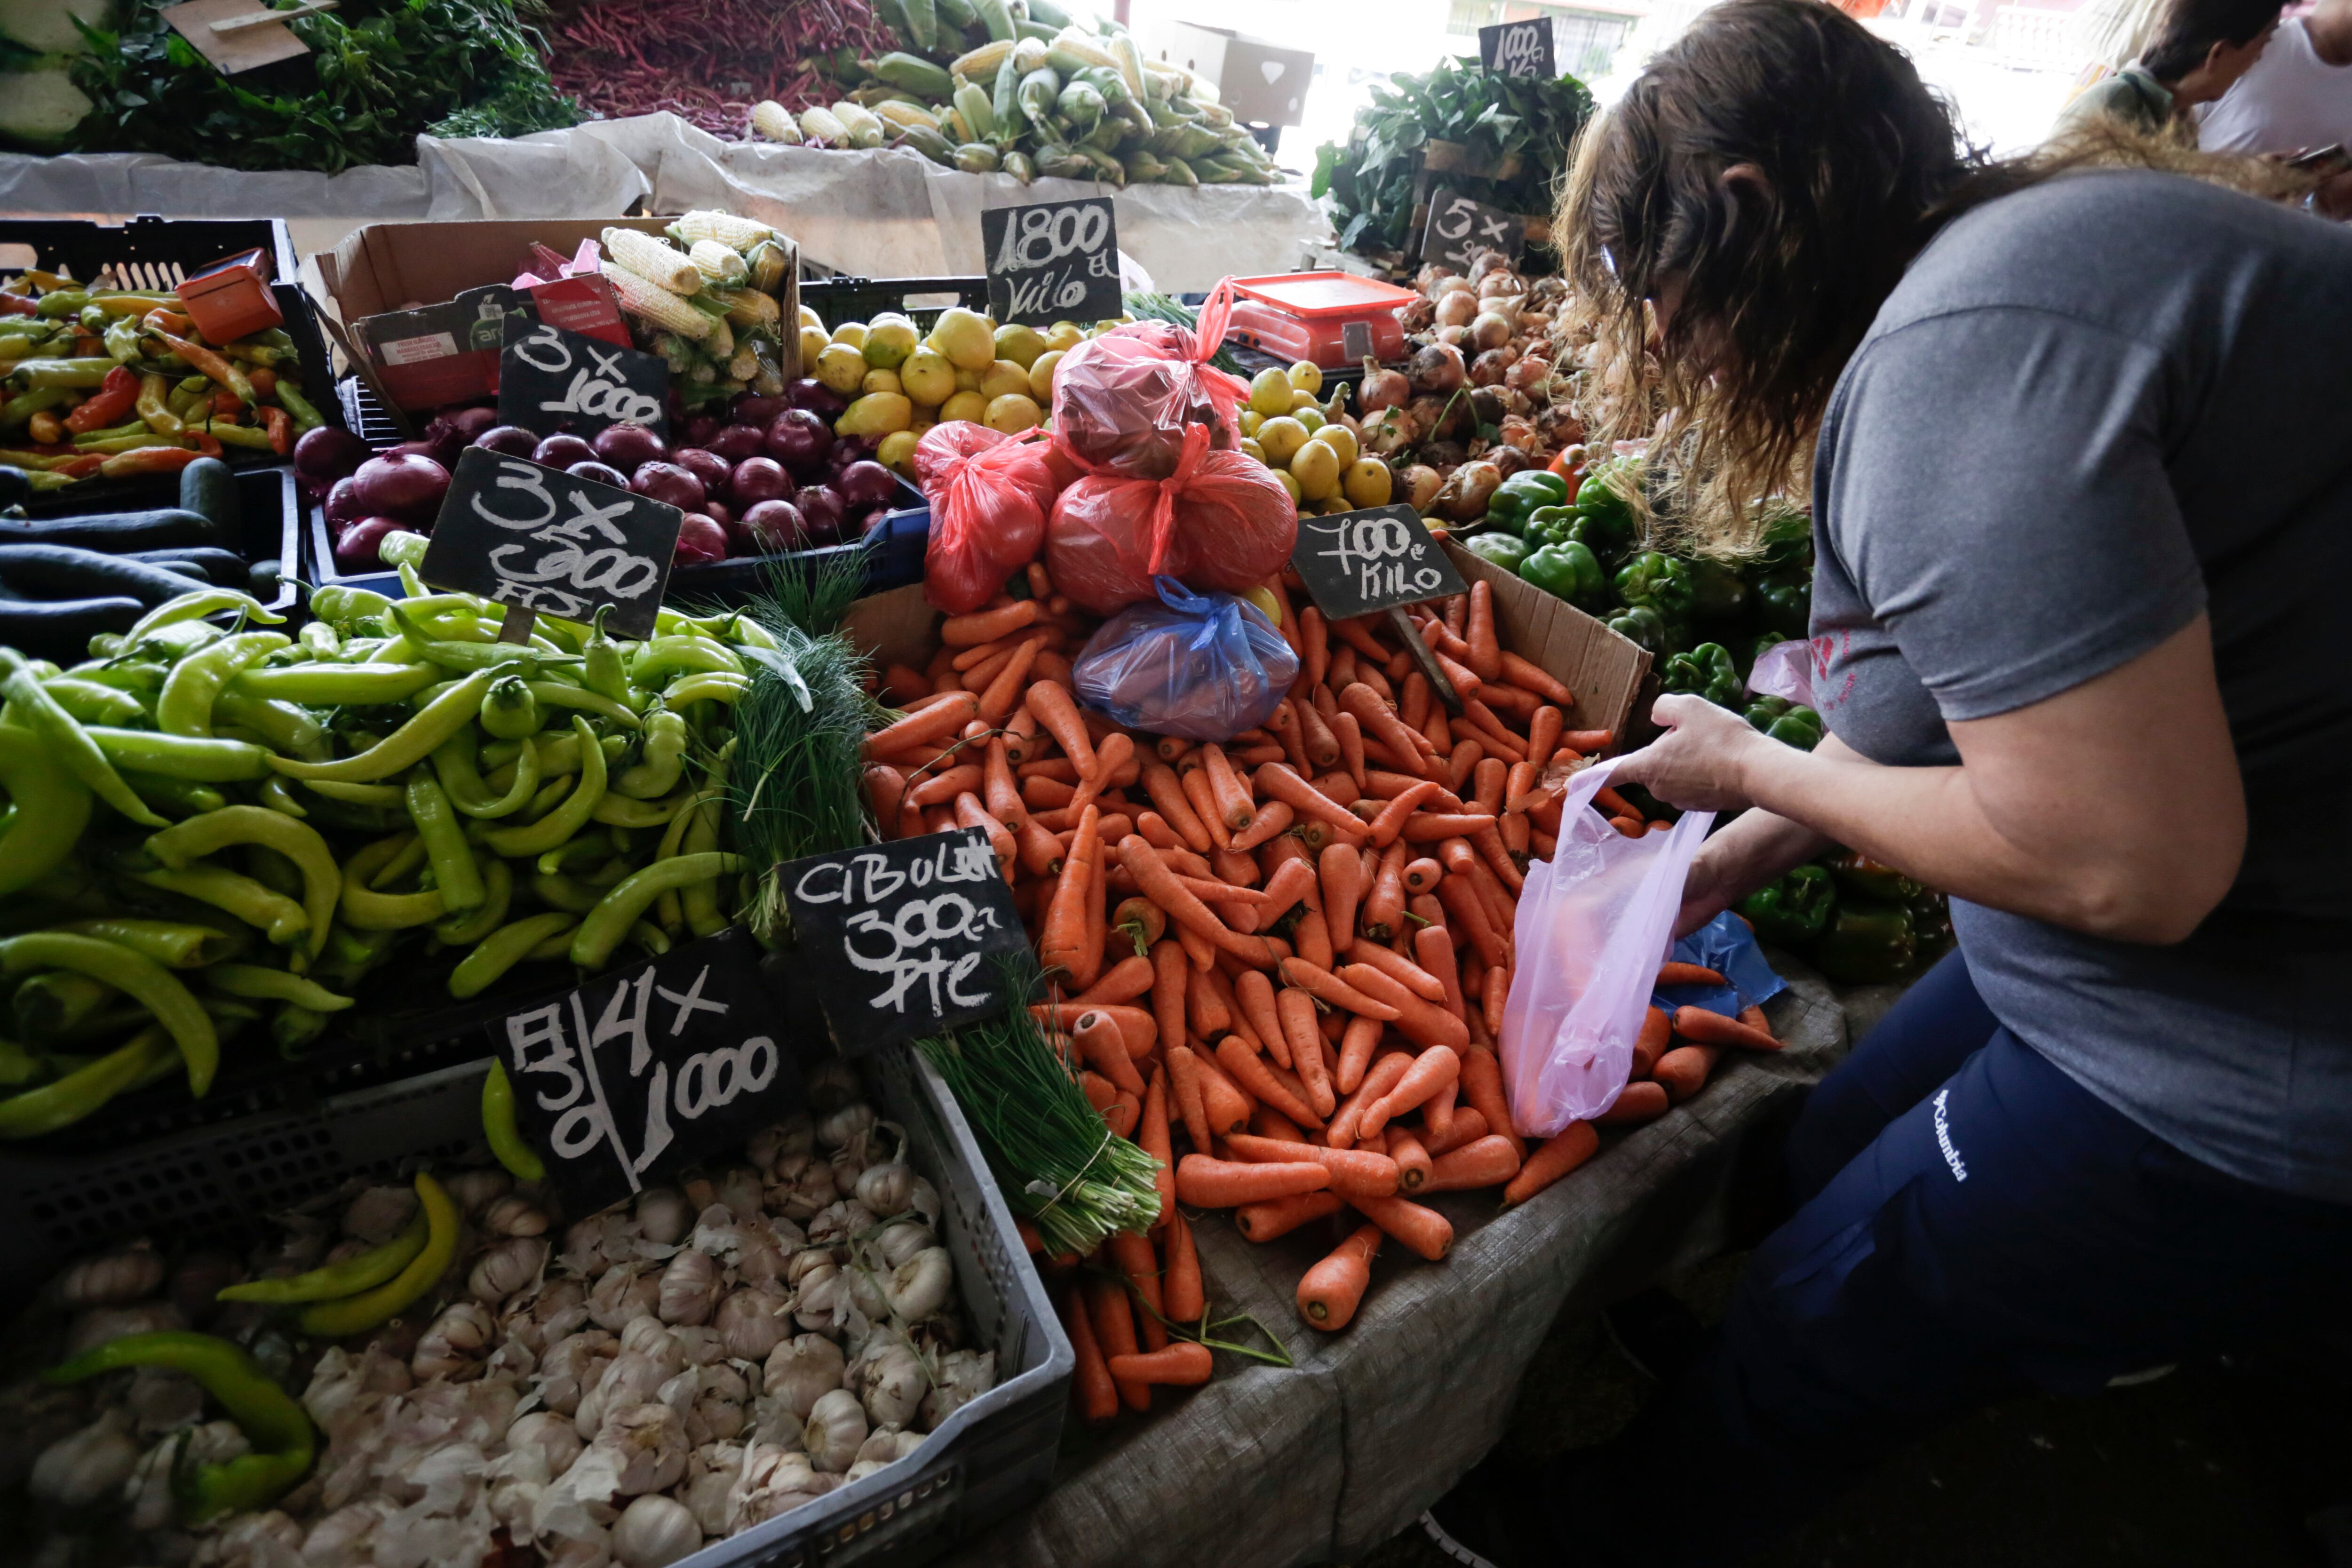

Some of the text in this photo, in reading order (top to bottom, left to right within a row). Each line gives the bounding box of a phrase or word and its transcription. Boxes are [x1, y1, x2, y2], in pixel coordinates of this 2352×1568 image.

[992, 204, 1109, 275] 1800
[1306, 518, 1411, 575] 700
[1360, 562, 1442, 600] KILO
[844, 893, 977, 974] 300
[633, 1036, 779, 1174] 1000
[1934, 1105, 1968, 1182] Columbia
